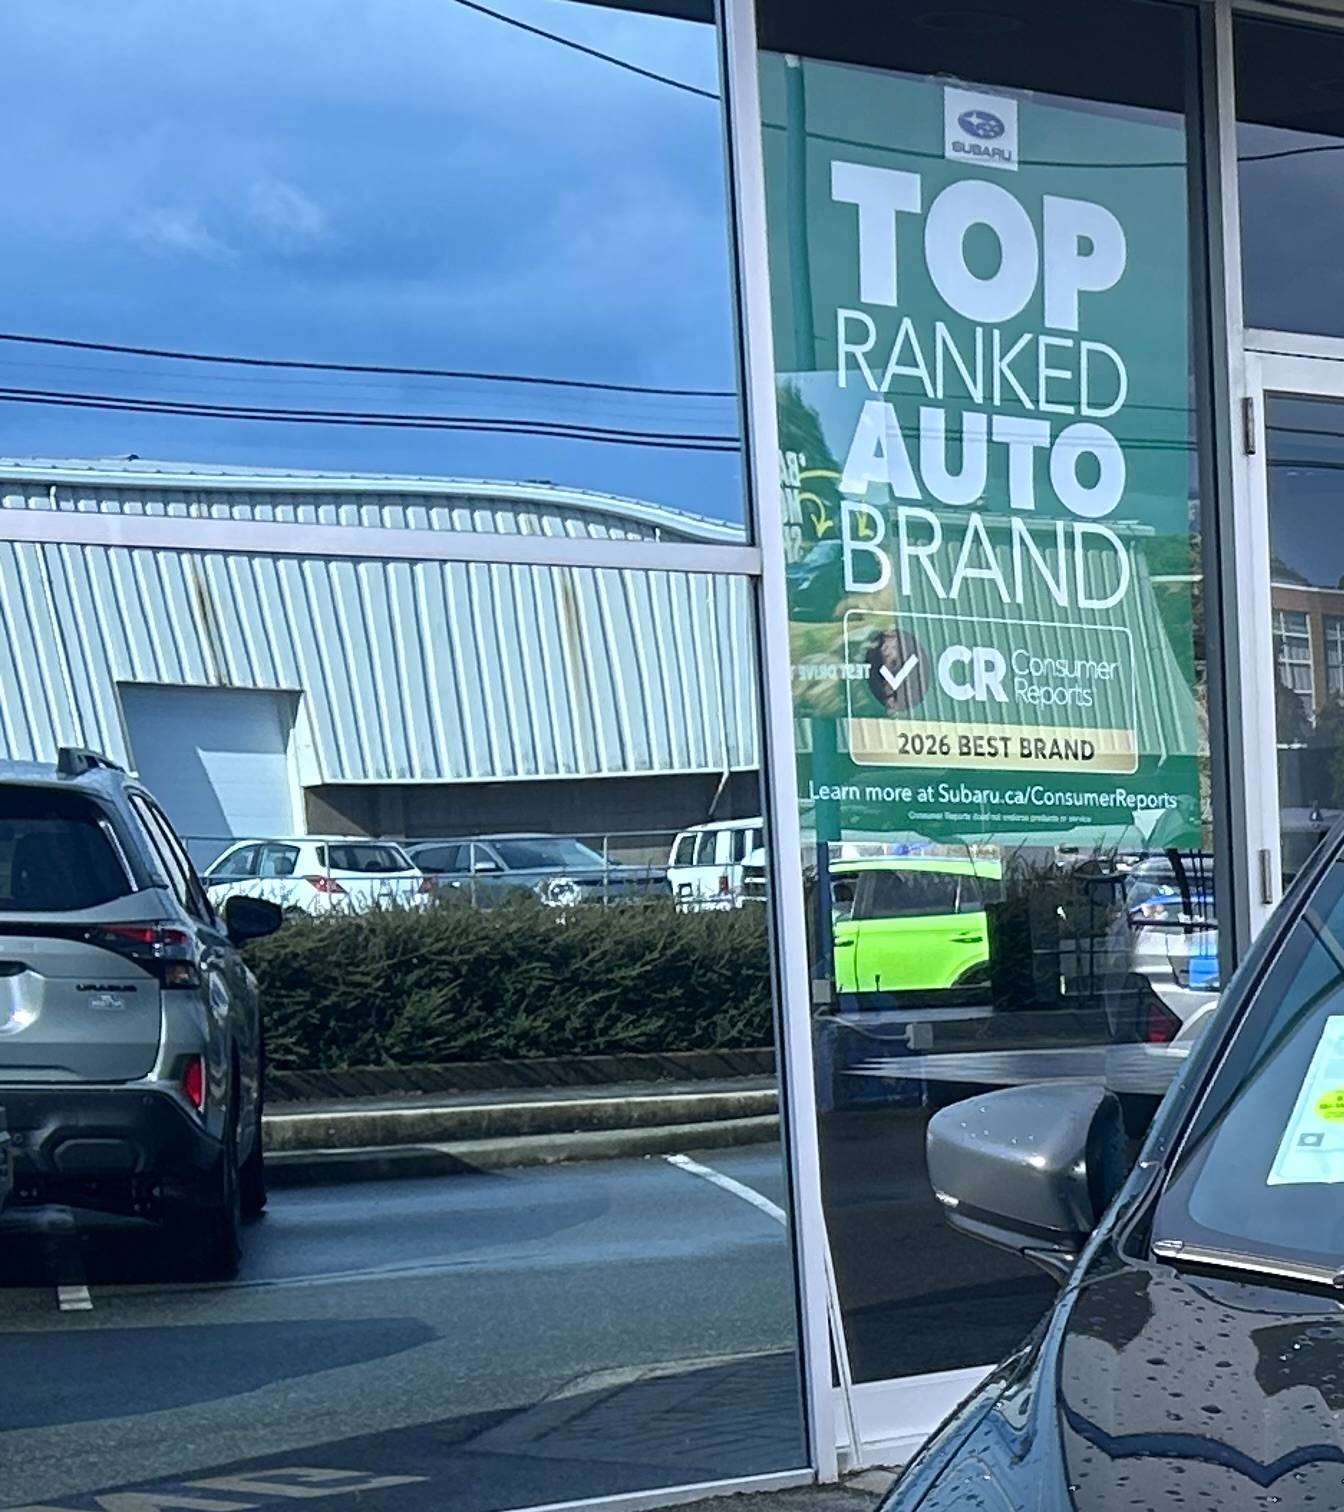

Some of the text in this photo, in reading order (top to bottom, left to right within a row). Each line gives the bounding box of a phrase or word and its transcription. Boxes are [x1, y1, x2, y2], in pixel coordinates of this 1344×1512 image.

[952, 141, 1012, 162] SUBARU
[831, 160, 1127, 332] TOP
[837, 307, 1128, 418] RANKED
[839, 400, 1126, 519] AUTO
[841, 501, 1131, 610] BRAND
[938, 645, 1009, 703] CR
[1012, 649, 1120, 681] Consumer
[1014, 678, 1093, 710] Reports
[898, 732, 1096, 761] 2026 BEST BRAND
[809, 780, 1178, 810] Learn more at Subaru.ca/ConsumerReports
